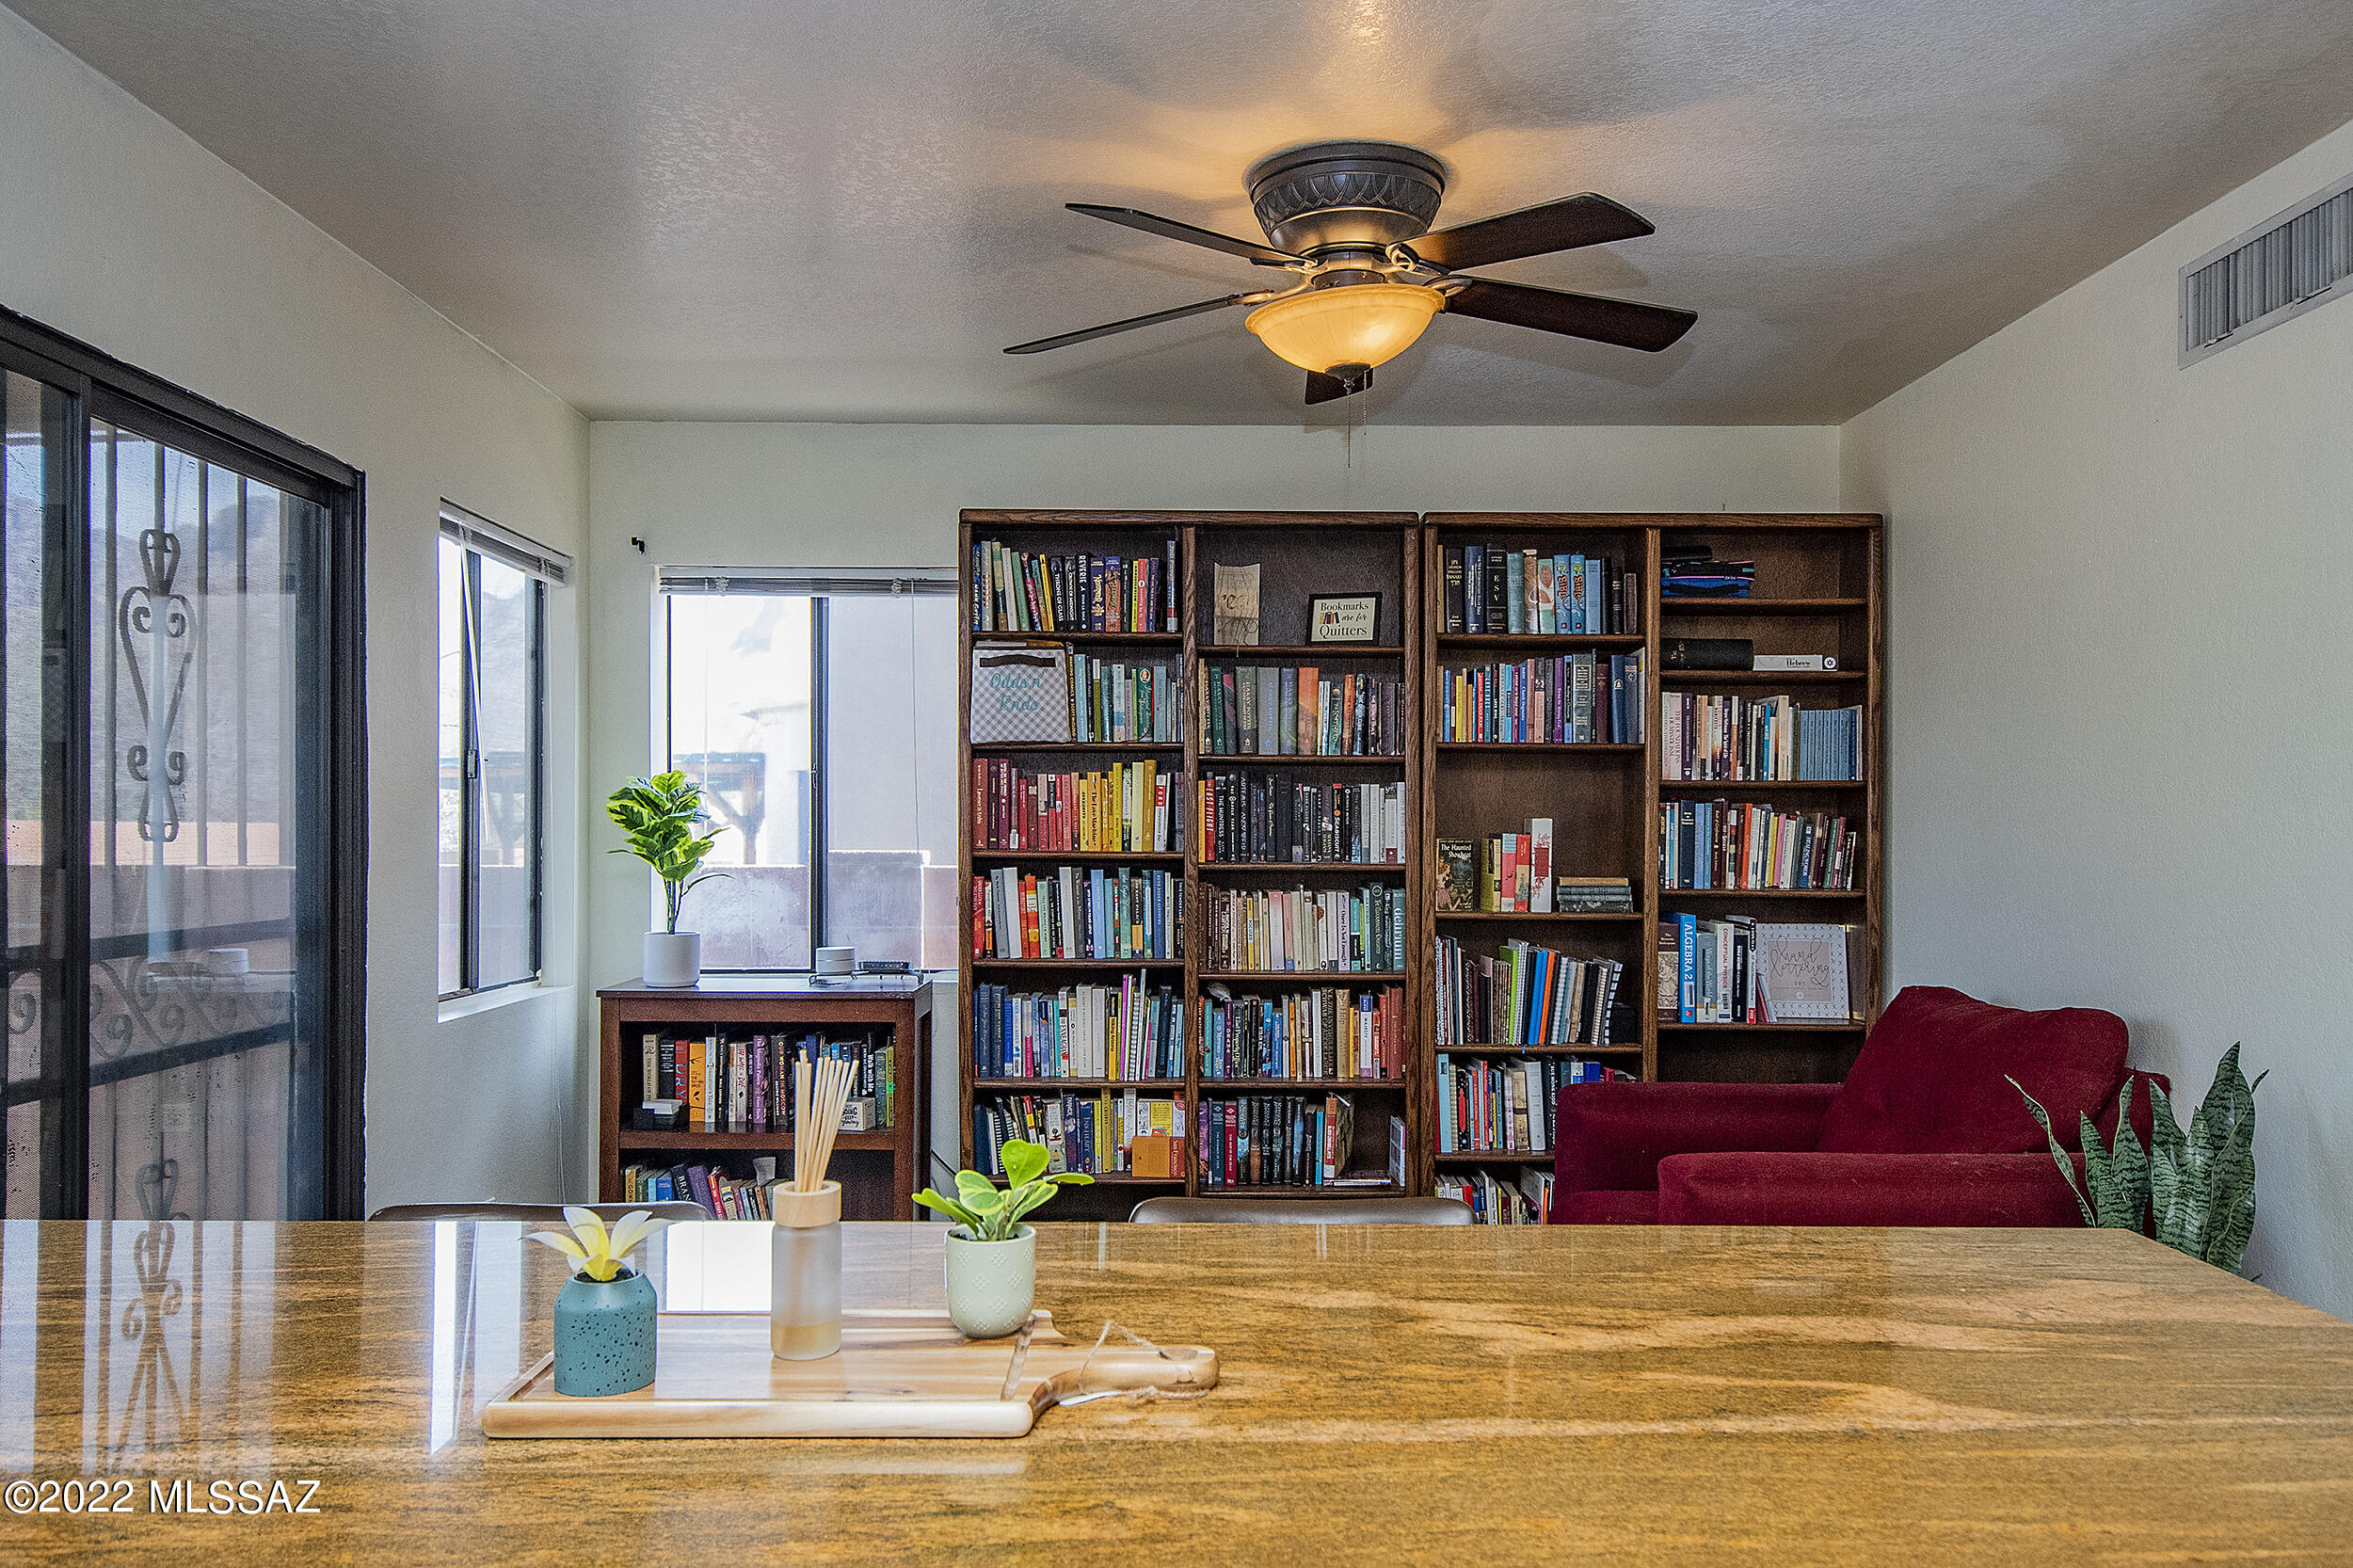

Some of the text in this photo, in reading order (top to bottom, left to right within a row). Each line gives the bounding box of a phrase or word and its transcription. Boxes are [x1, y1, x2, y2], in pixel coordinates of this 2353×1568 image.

[1321, 601, 1369, 611] Bookmarks
[1355, 613, 1367, 622] for
[1319, 624, 1367, 639] Quitters
[990, 672, 1028, 689] Odds
[999, 692, 1038, 712] Ends
[1394, 908, 1404, 959] delirium
[1684, 924, 1693, 972] ALGEBRA
[1777, 936, 1821, 963] hand
[675, 1063, 687, 1099] DRY
[867, 1083, 874, 1092] Me
